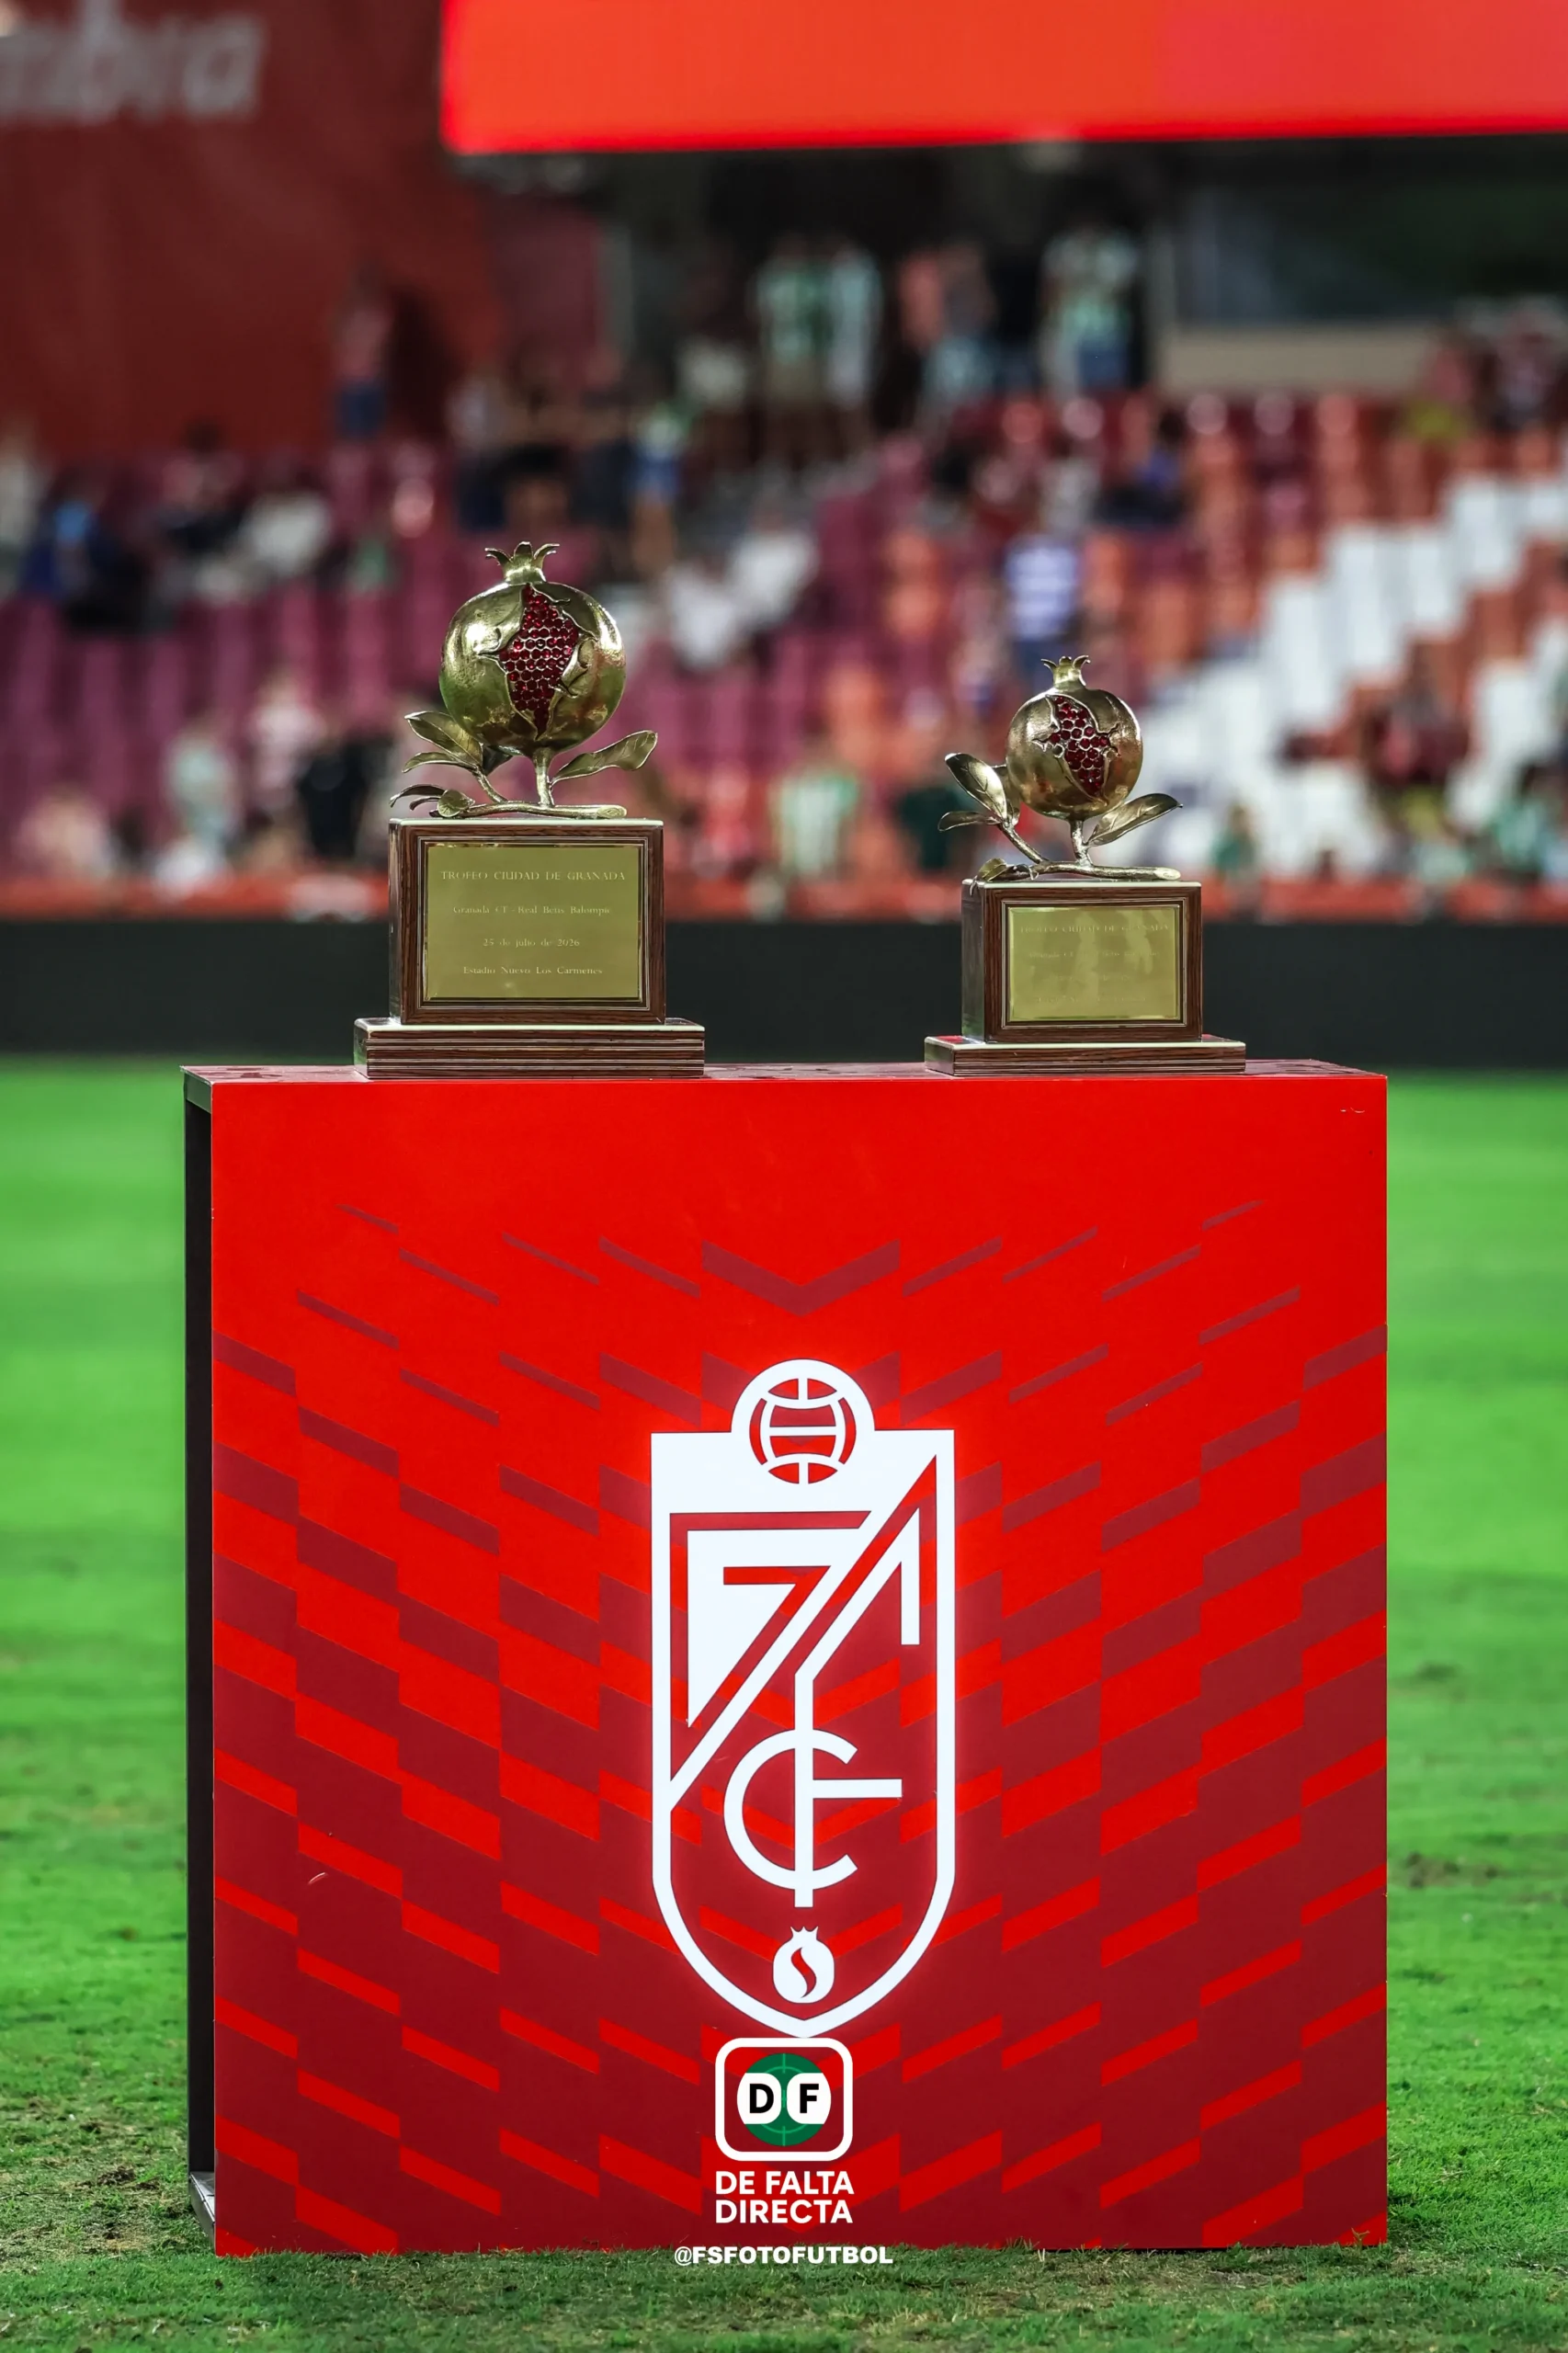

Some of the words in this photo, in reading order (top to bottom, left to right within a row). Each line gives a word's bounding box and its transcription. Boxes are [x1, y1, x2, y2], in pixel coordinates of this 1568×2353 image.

[439, 870, 488, 881] TROFEO
[494, 870, 540, 881] CIUDAD
[545, 870, 561, 881] DE
[566, 870, 625, 881] GRANADA
[452, 904, 491, 915] Granada
[517, 904, 538, 915] Real
[482, 938, 494, 948] 25
[499, 937, 511, 948] de
[515, 937, 537, 949] julio
[540, 937, 551, 948] de
[556, 938, 581, 948] 2026
[462, 965, 496, 975] Estadio
[500, 965, 531, 975] Nuevo
[535, 965, 552, 975] Los
